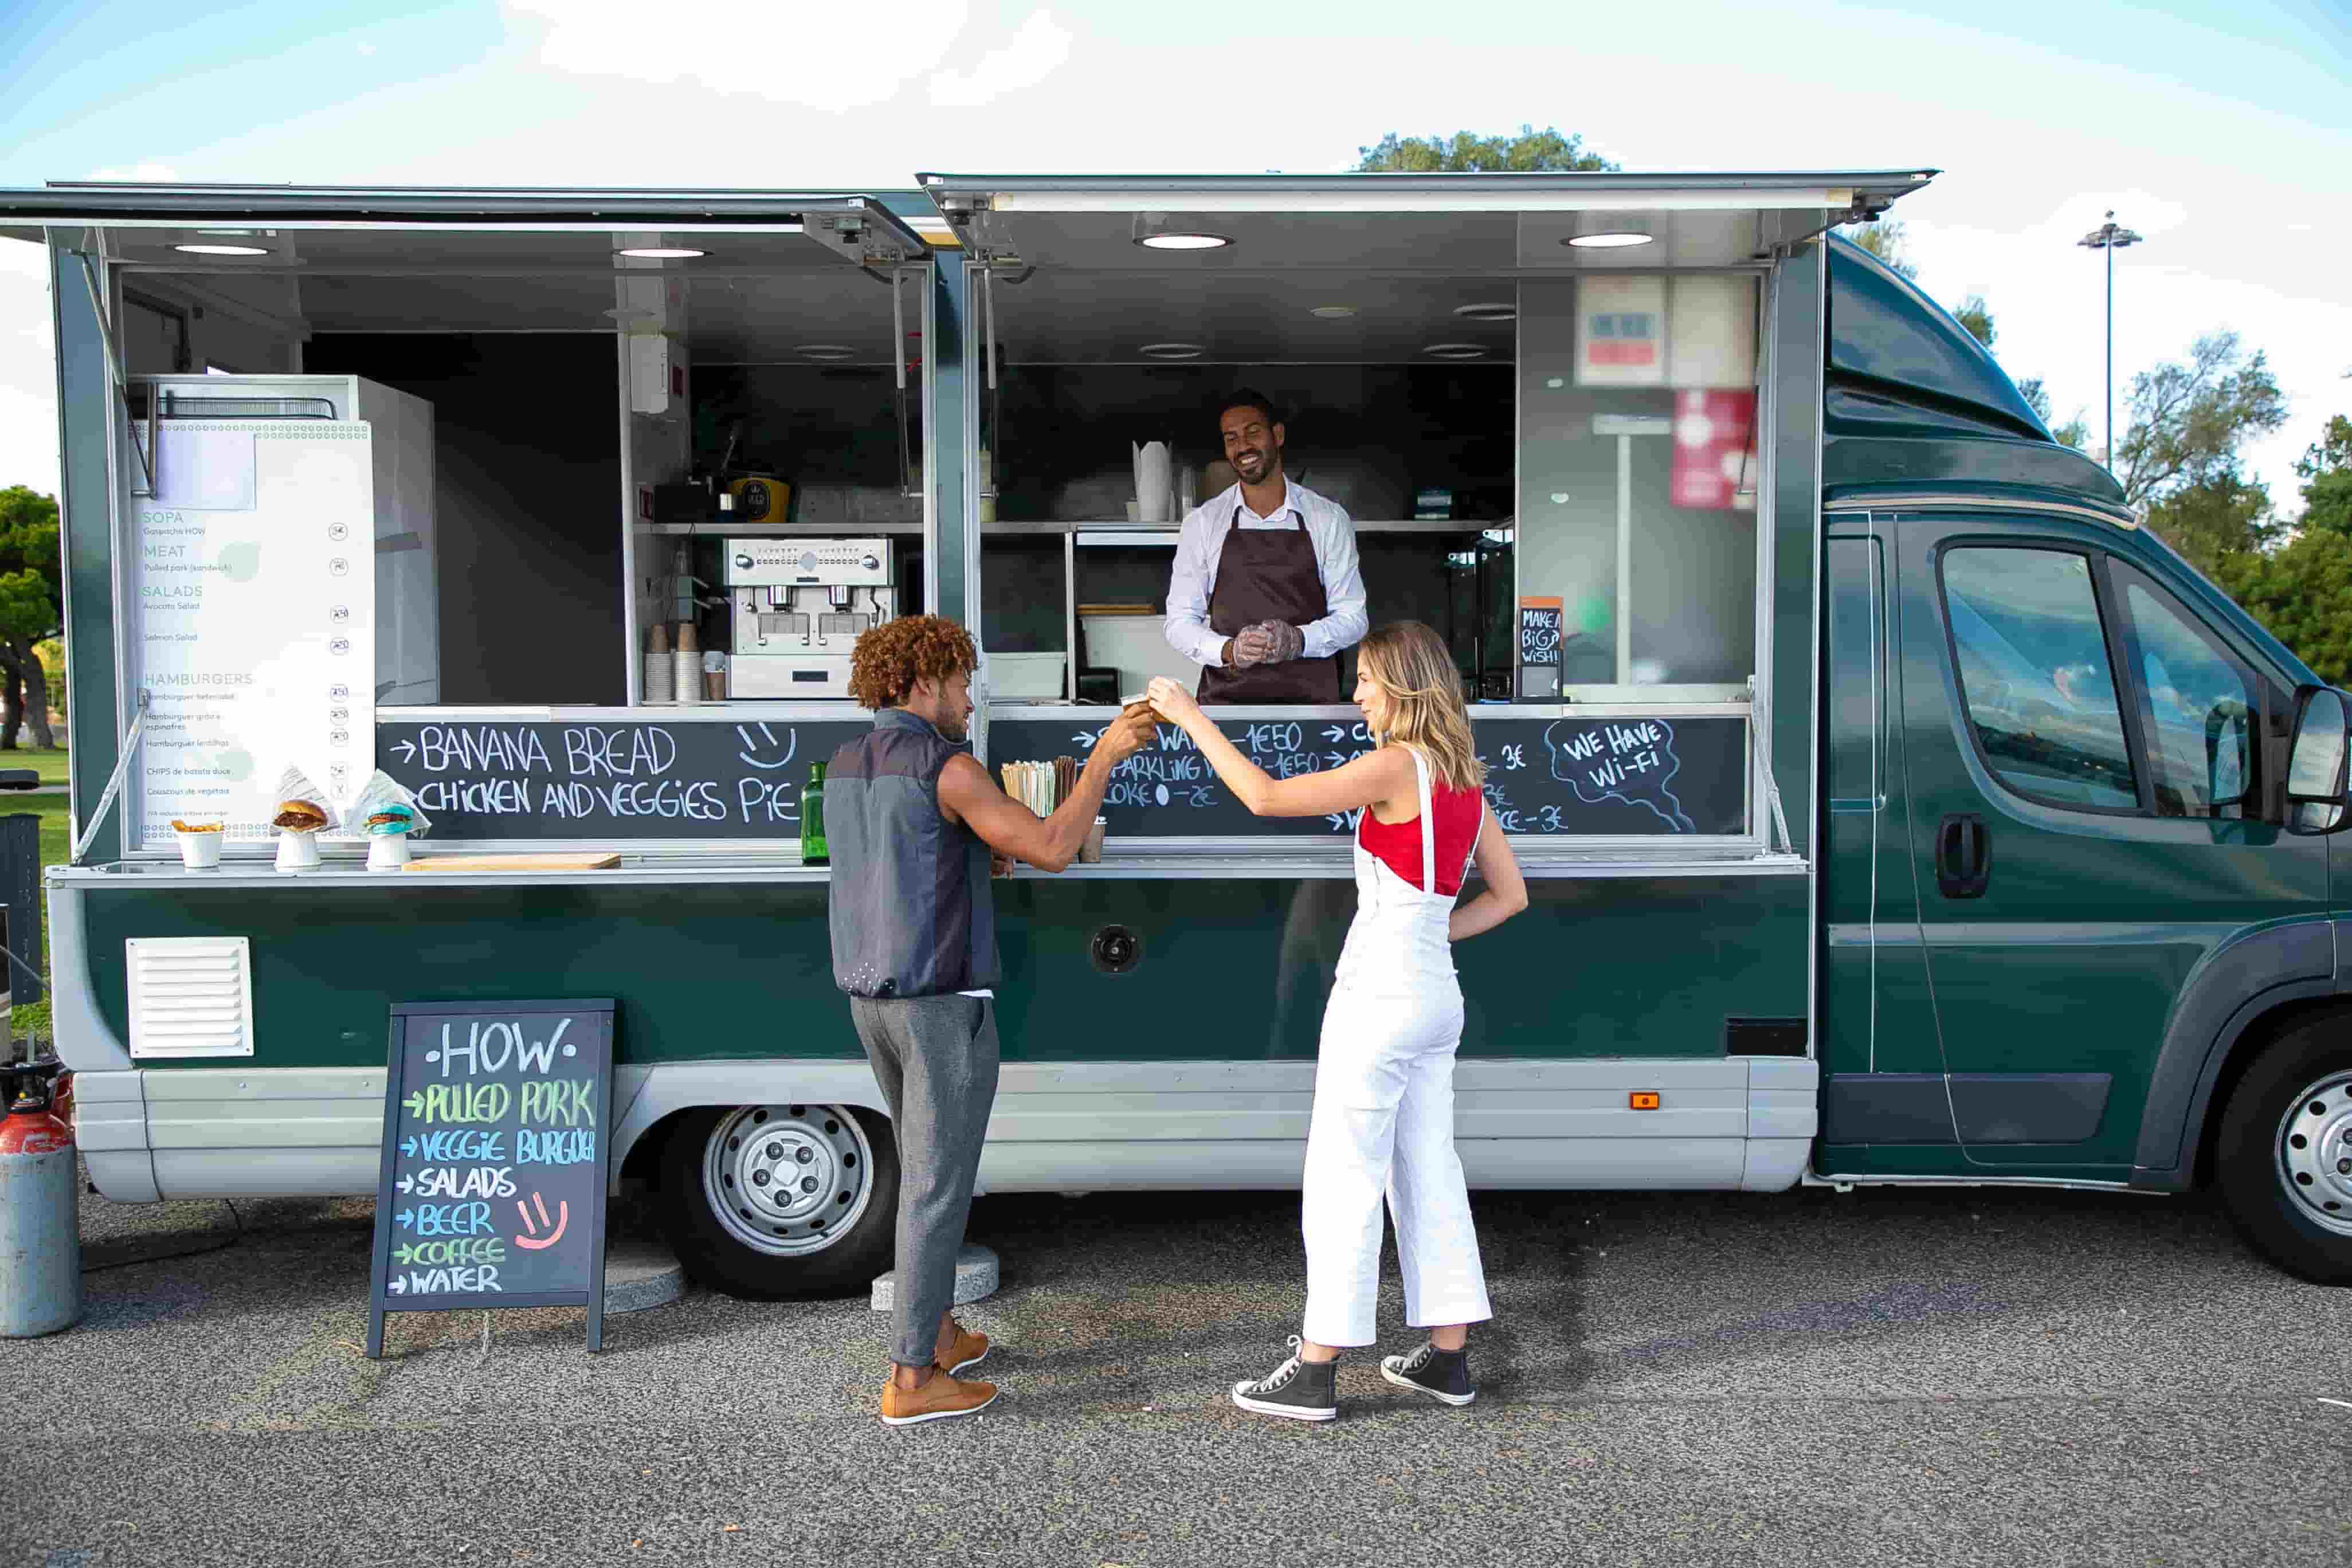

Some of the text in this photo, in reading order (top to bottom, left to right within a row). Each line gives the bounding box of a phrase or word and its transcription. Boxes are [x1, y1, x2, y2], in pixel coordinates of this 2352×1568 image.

[142, 512, 184, 523] SOPA
[144, 545, 186, 558] MEAT
[142, 585, 202, 597] SALADS
[1523, 610, 1553, 628] MAKE
[145, 673, 253, 685] HAMBURGERS
[420, 726, 676, 777] BANANA BREAD
[1563, 722, 1661, 761] WE HAVE
[542, 782, 595, 818] AND
[426, 1079, 596, 1127] PULLED PORK
[416, 1167, 516, 1198] SALADS
[417, 1201, 494, 1236] BEER
[413, 1237, 506, 1265] COFFEE
[410, 1265, 503, 1294] WATER
